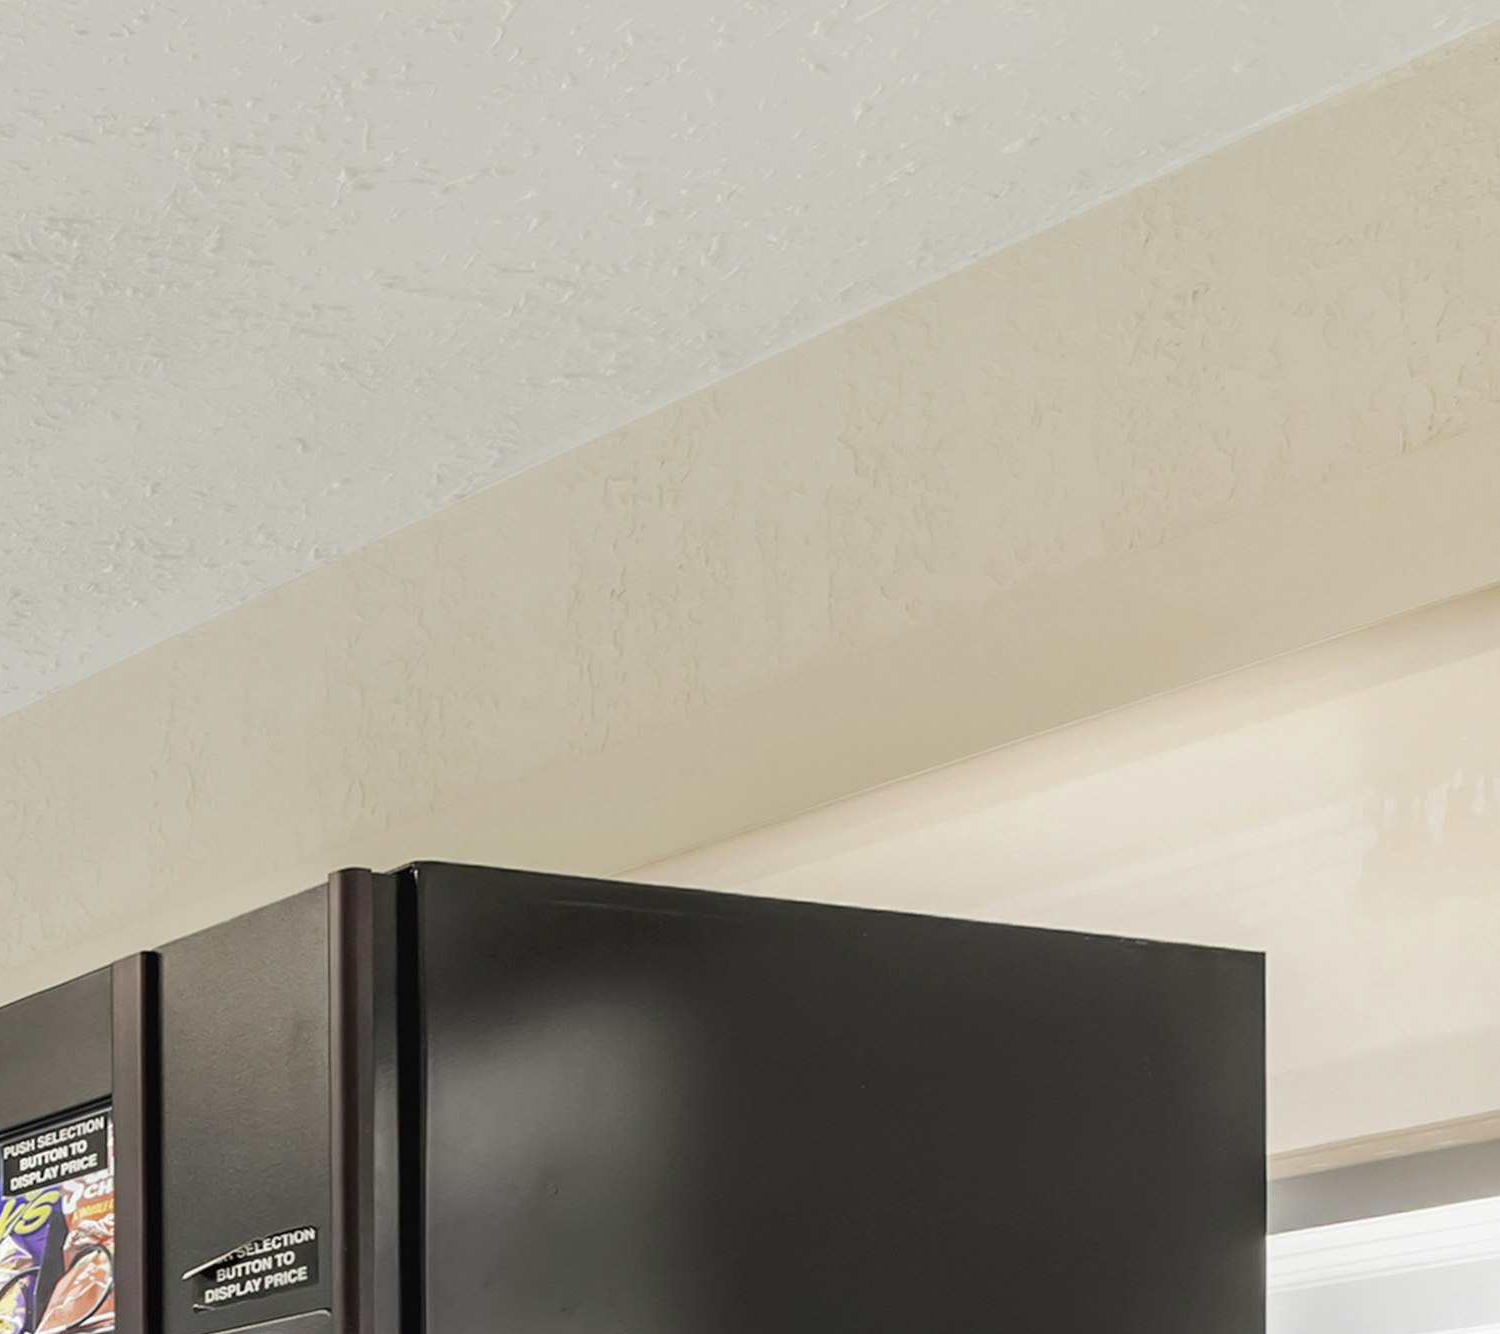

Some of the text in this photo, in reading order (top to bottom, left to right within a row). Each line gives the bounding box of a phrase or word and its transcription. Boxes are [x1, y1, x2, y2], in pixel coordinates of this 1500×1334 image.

[3, 1117, 105, 1160] PUSH SELECTION
[19, 1139, 88, 1171] BUTTON TO
[10, 1153, 98, 1192] DISPLAY PRICE
[204, 1265, 309, 1304] DISPLAY PRICE
[216, 1250, 296, 1283] BUTTON TO
